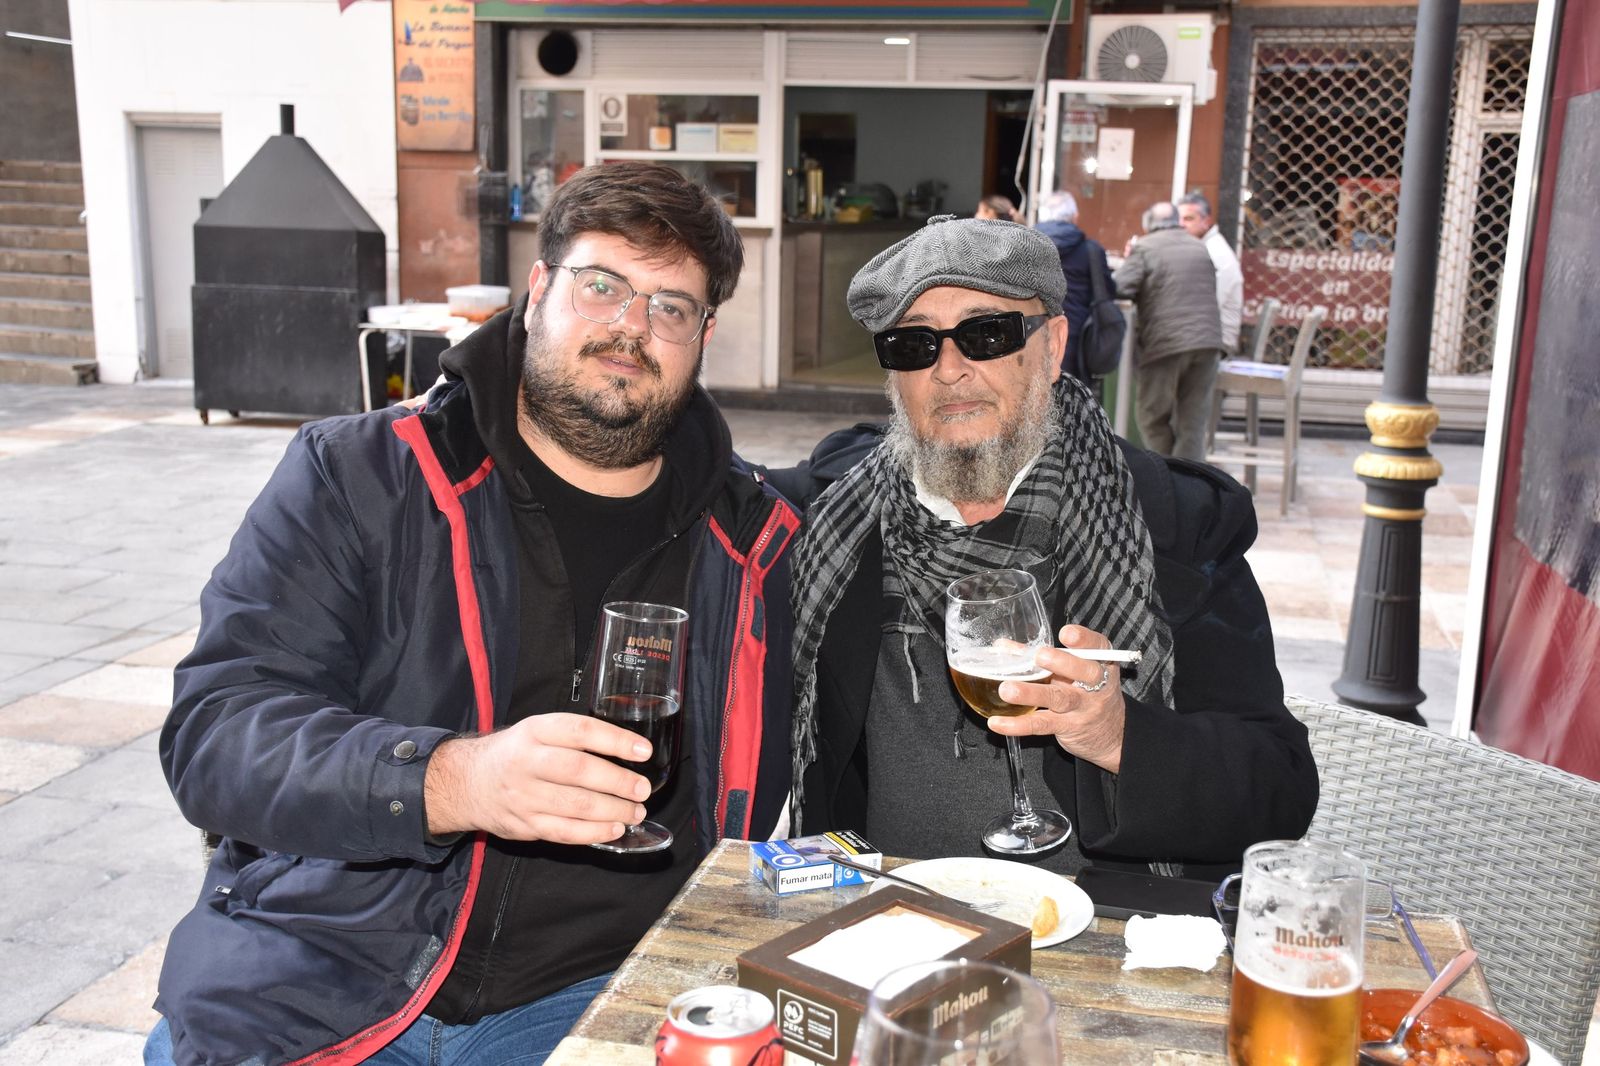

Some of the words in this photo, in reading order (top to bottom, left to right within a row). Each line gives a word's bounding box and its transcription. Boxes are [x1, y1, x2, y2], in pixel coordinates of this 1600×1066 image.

[1265, 250, 1395, 272] Especialida
[1322, 280, 1350, 296] en
[1362, 304, 1390, 323] br
[780, 876, 808, 885] Fumar
[810, 872, 832, 881] mata
[932, 985, 988, 1030] Mahou
[783, 1020, 804, 1035] PEFC
